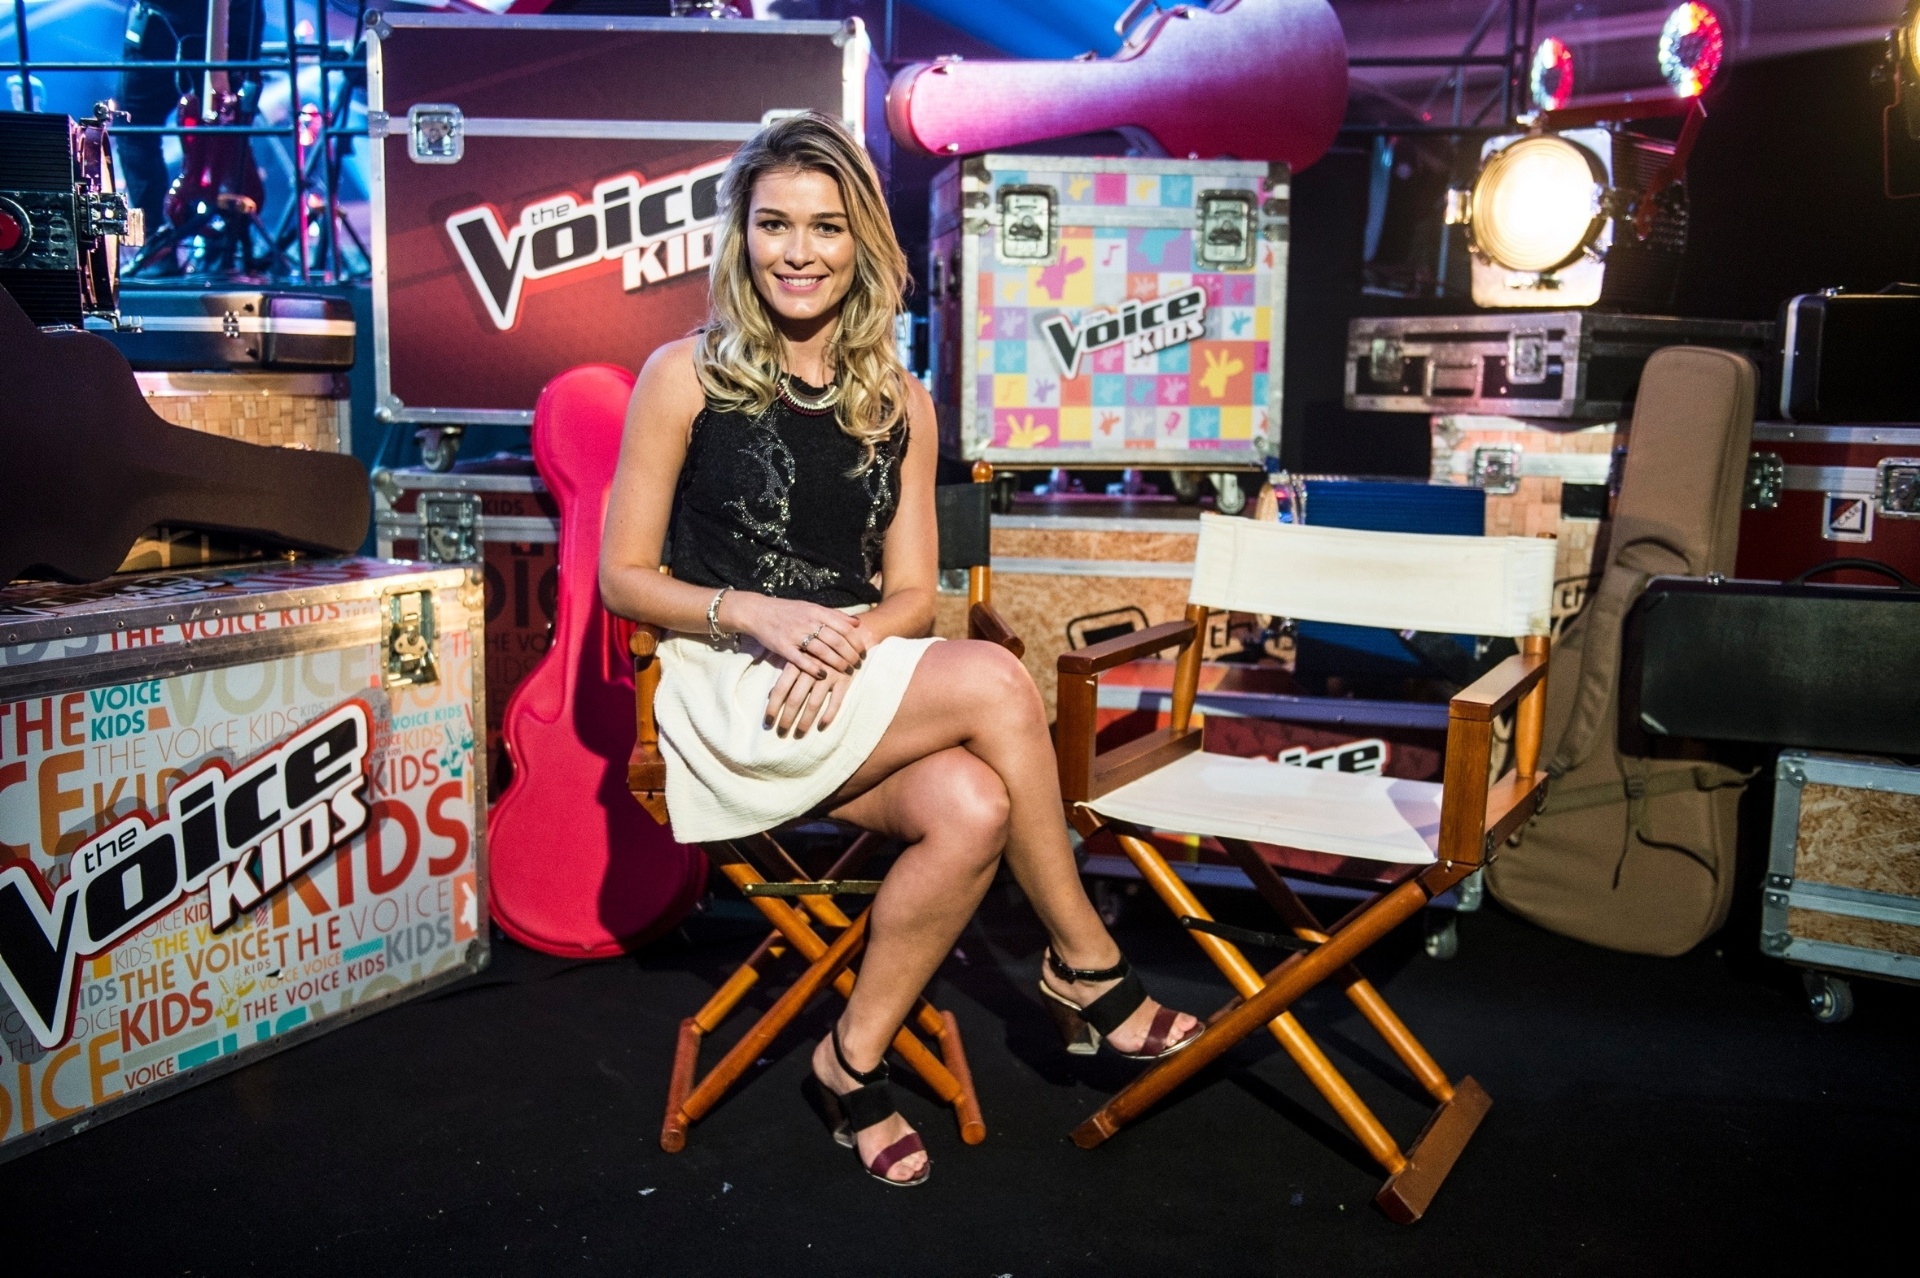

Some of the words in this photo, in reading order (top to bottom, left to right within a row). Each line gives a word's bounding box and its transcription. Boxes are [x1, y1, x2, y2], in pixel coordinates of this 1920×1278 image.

[531, 202, 570, 225] the
[623, 233, 718, 292] KID
[1048, 292, 1201, 370] Voice
[1133, 318, 1204, 359] KIDS
[180, 613, 267, 642] VOICE
[279, 602, 341, 628] KIDS
[90, 680, 161, 713] VOICE
[391, 711, 430, 731] VOICE
[435, 704, 462, 721] KIDS
[91, 711, 146, 741] KIDS
[92, 737, 147, 776] THE
[157, 719, 239, 763] VOICE
[249, 706, 300, 744] KIDS
[404, 724, 444, 752] KIDS
[367, 748, 440, 800] KIDS
[84, 827, 138, 874] the
[209, 775, 367, 930] KIDS
[0, 717, 358, 1034] Voice
[184, 902, 211, 926] KID
[350, 877, 450, 941] VOICE
[115, 942, 153, 973] KIDS
[152, 929, 189, 959] THE
[274, 915, 342, 968] THE
[303, 952, 342, 976] VOICE
[385, 914, 452, 969] KIDS
[119, 958, 177, 1004] THE
[184, 927, 270, 981] VOICE
[244, 959, 271, 976] KIDS
[244, 993, 278, 1021] THE
[286, 971, 340, 1006] VOICE
[347, 953, 386, 984] KIDS
[80, 977, 118, 1010] IDS
[72, 1005, 119, 1040] OICE
[120, 981, 213, 1053] KIDS
[124, 1057, 175, 1090] VOICE
